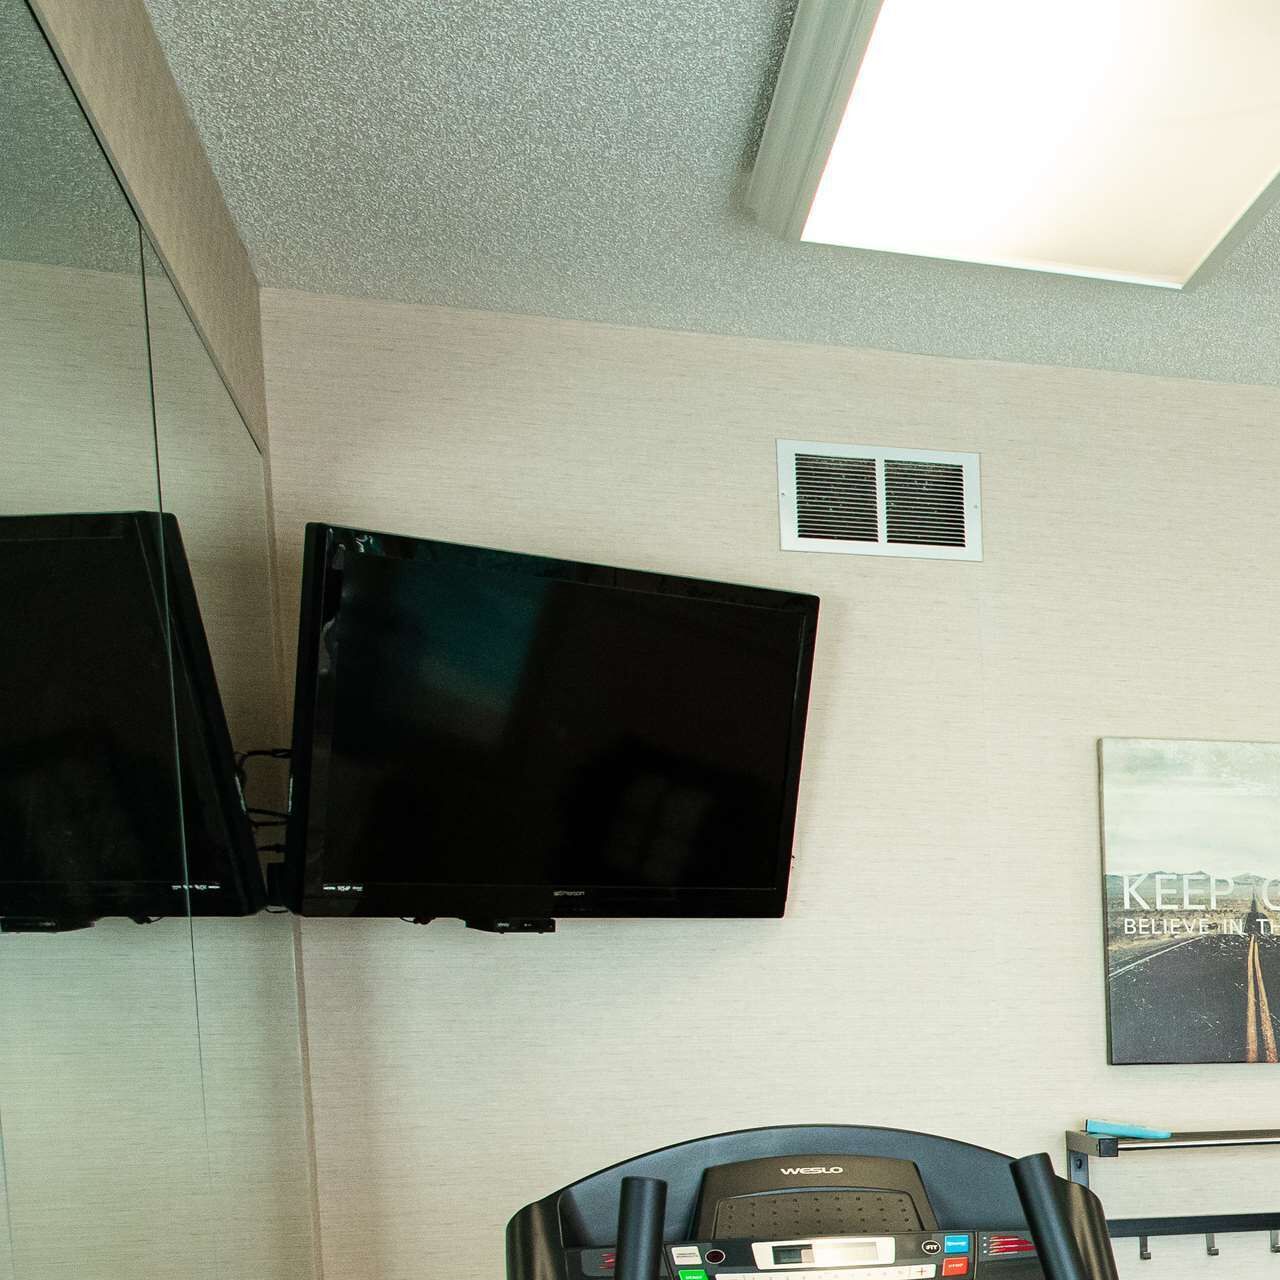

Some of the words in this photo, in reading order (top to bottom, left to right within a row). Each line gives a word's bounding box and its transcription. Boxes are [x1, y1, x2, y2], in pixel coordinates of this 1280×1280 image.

[1122, 873, 1235, 910] KEEP
[1124, 918, 1210, 935] BELIEVE
[1223, 919, 1244, 936] IN
[780, 1166, 844, 1175] WESLO
